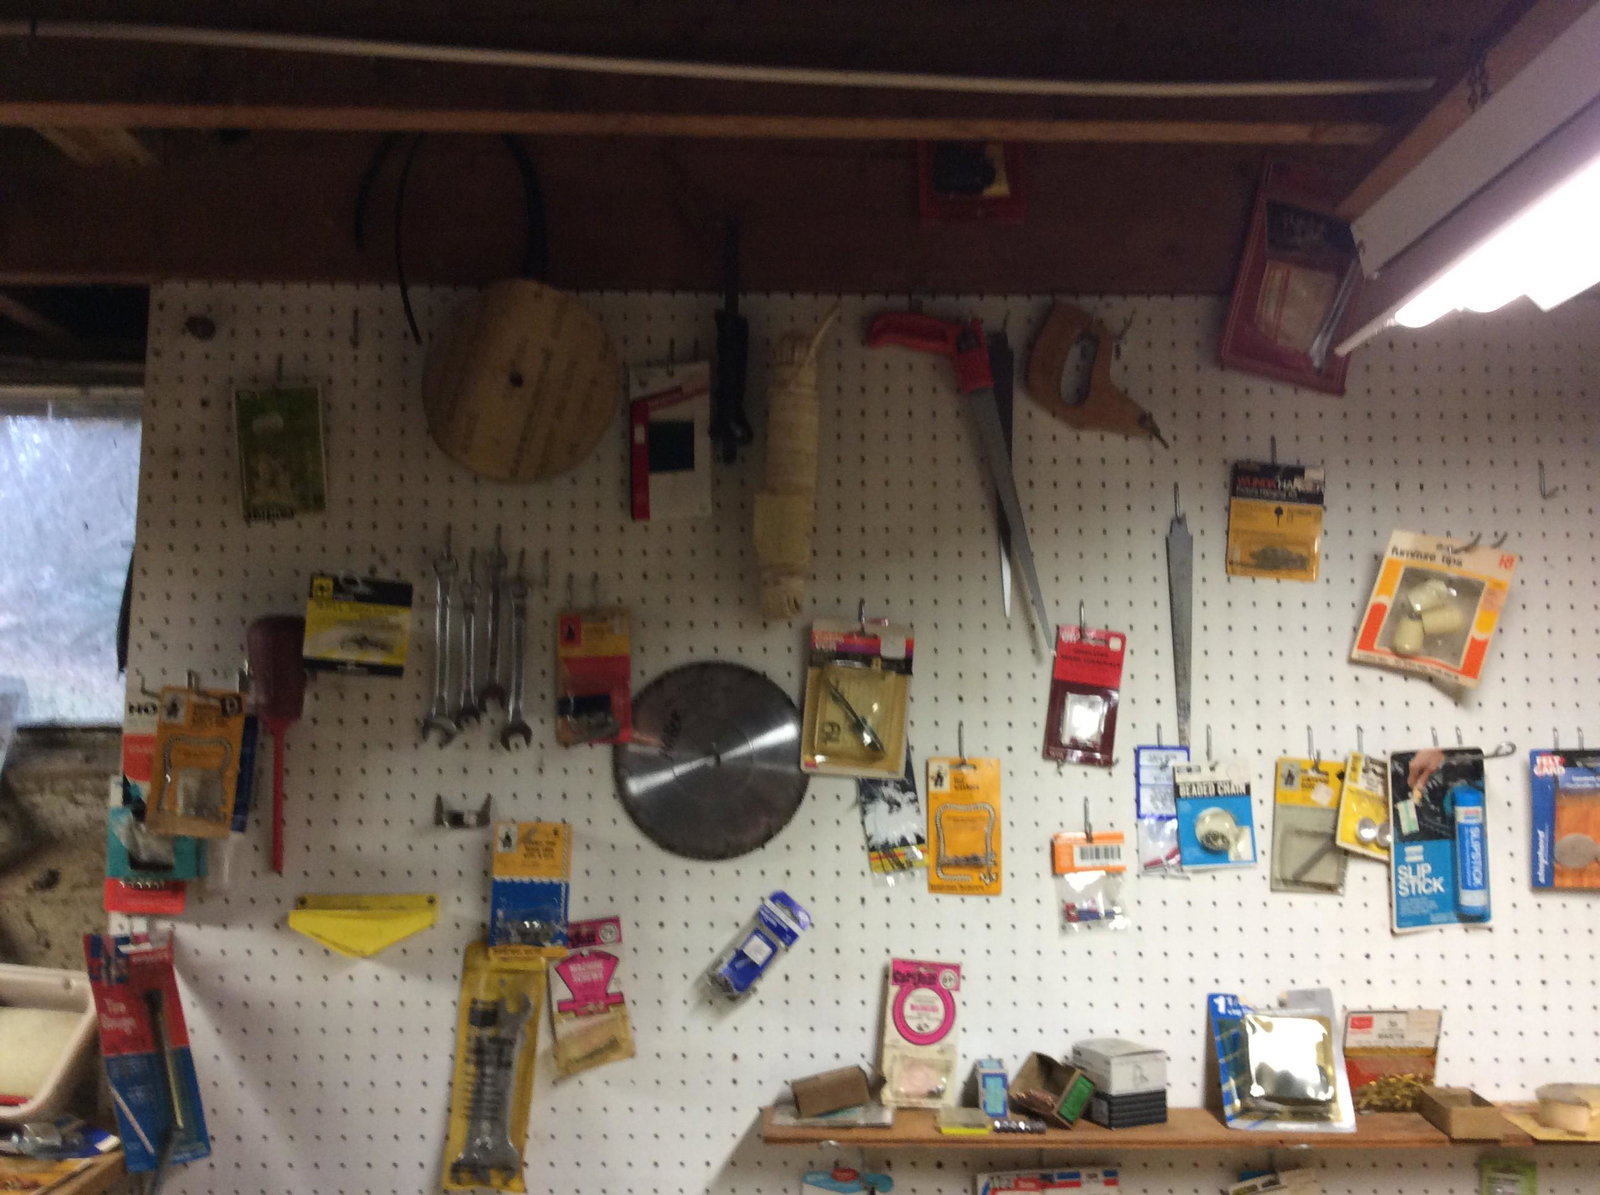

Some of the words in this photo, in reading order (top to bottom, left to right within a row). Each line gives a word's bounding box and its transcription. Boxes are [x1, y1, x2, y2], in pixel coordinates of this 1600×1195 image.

[1535, 755, 1562, 767] FELT
[1178, 781, 1216, 798] BEADED
[1216, 780, 1246, 797] CHAIN
[1397, 862, 1432, 879] SLIP
[1397, 876, 1446, 898] STICK
